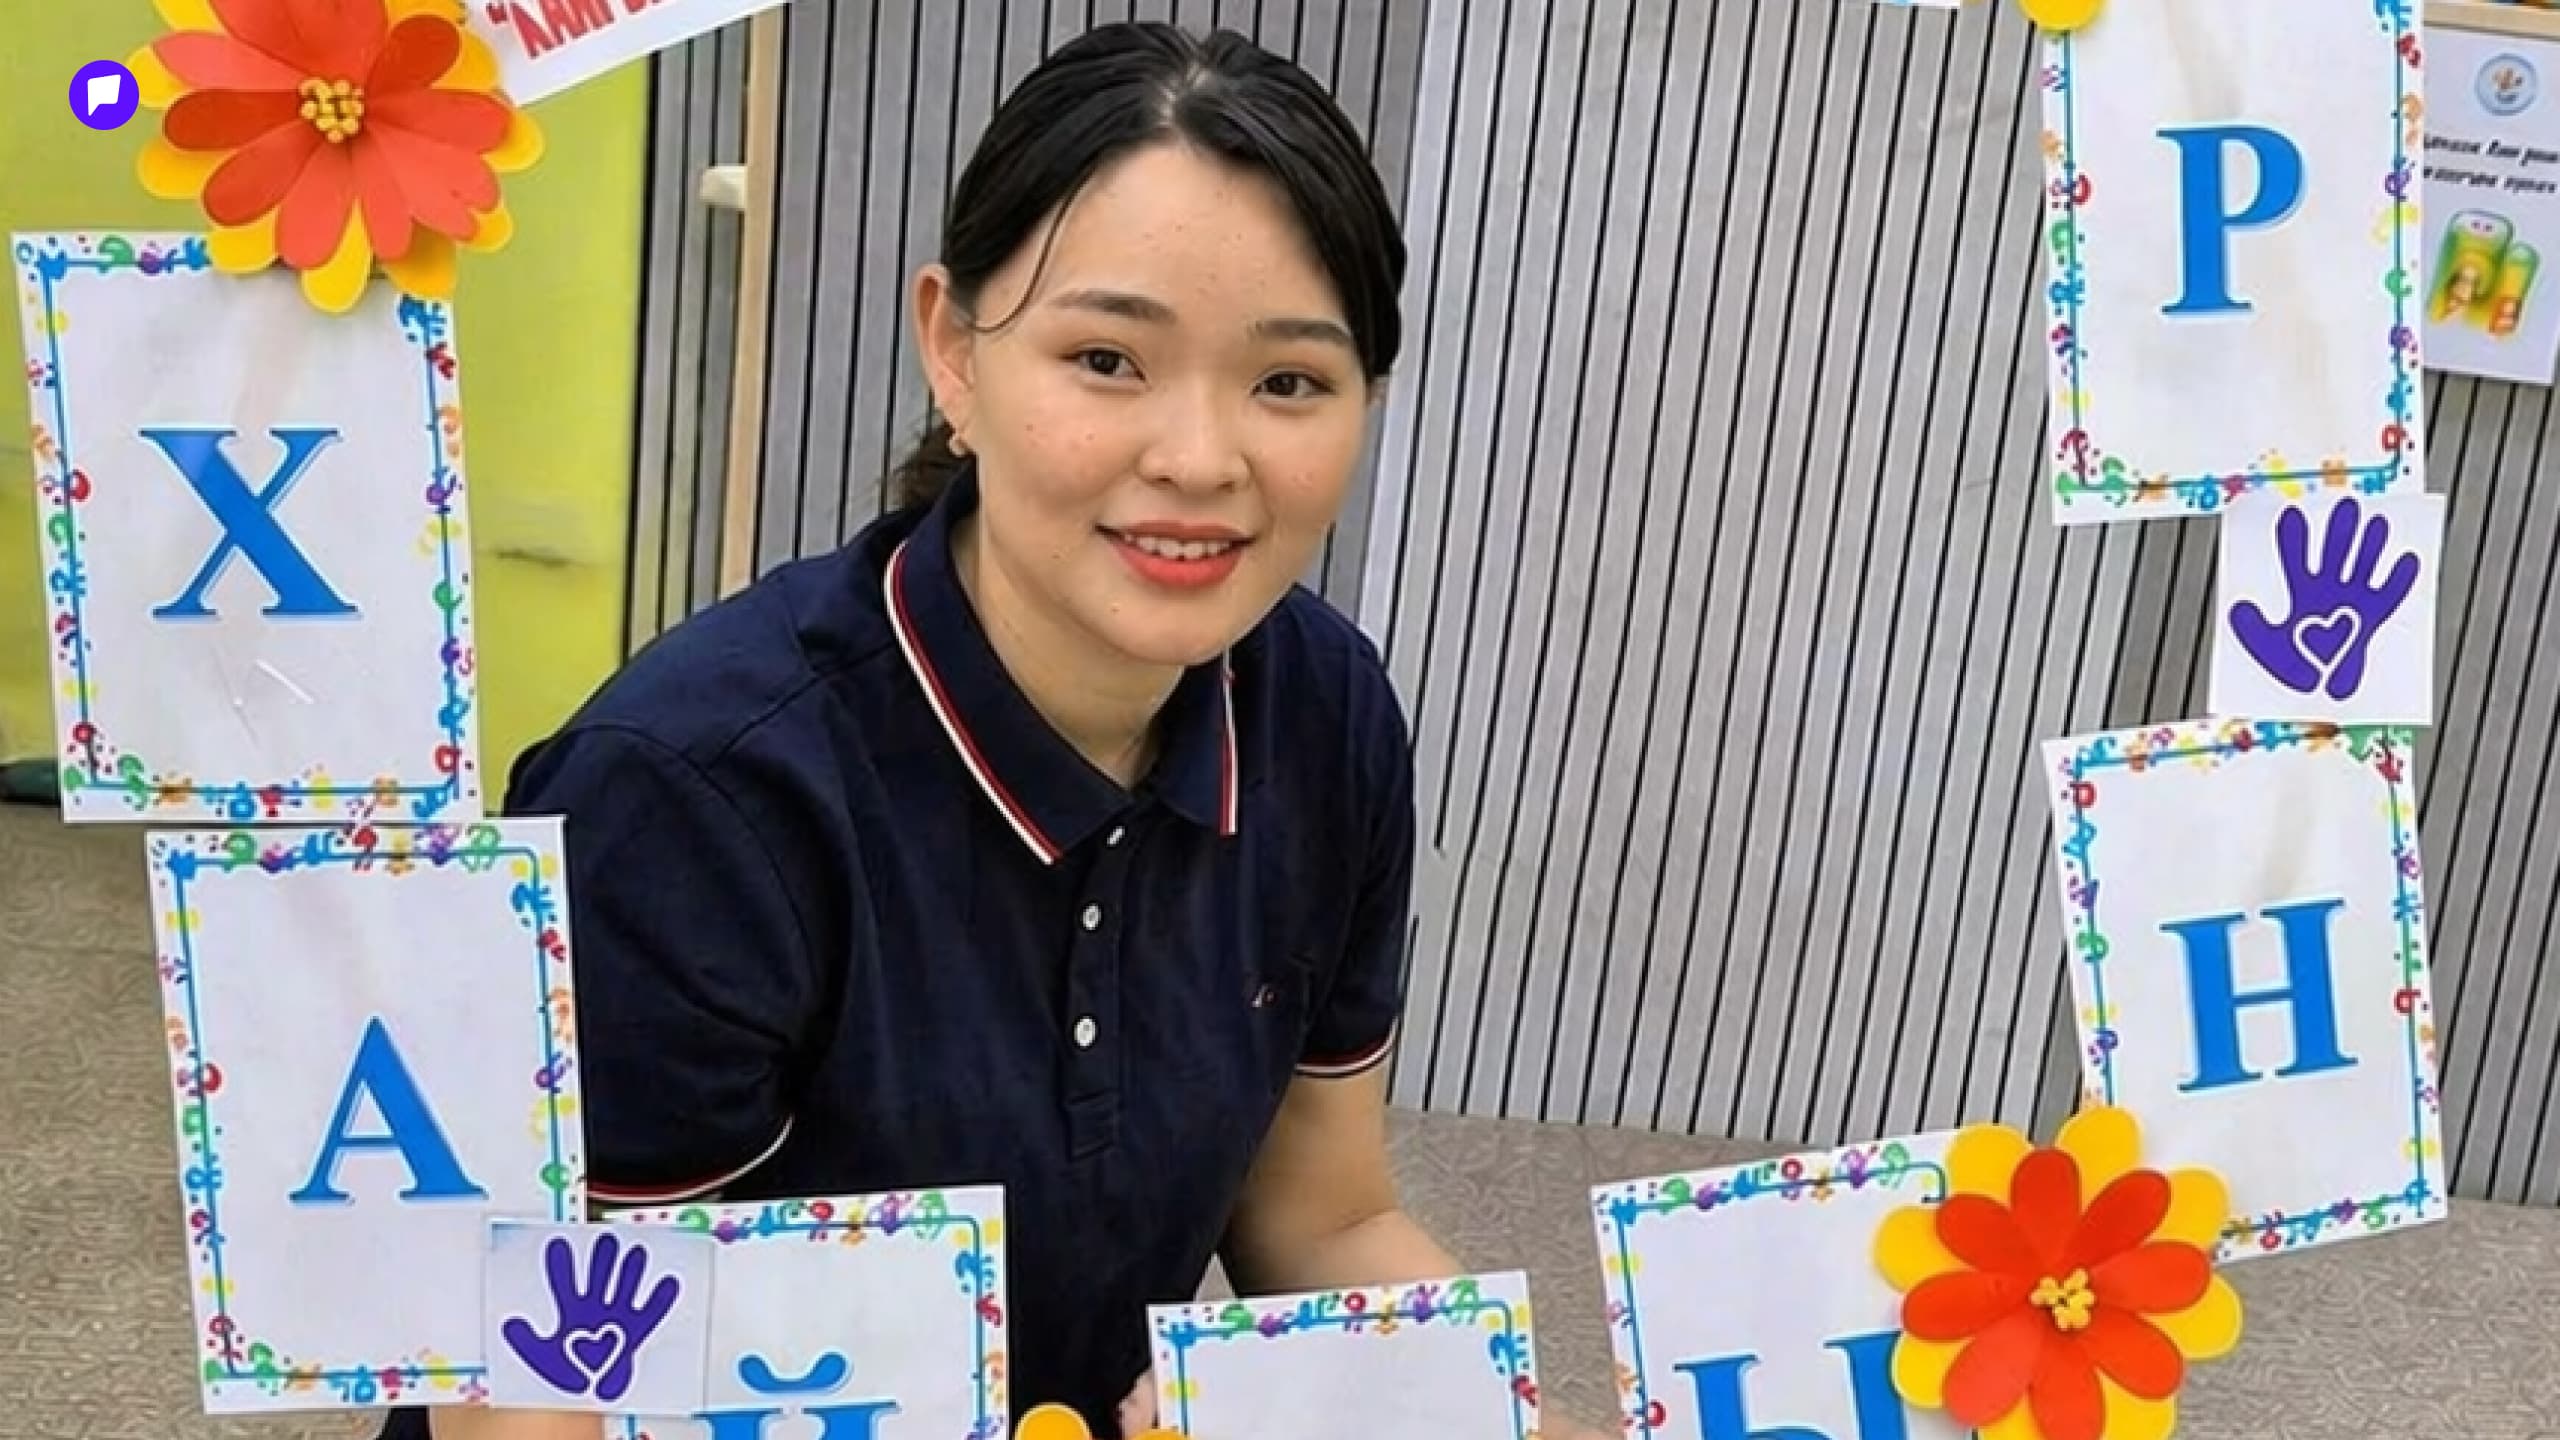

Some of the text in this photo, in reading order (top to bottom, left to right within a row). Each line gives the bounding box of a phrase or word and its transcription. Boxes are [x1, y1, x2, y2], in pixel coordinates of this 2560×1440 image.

[2155, 125, 2305, 316] Р
[138, 428, 360, 619] Х
[2158, 897, 2359, 1092] Н
[289, 1016, 489, 1202] А
